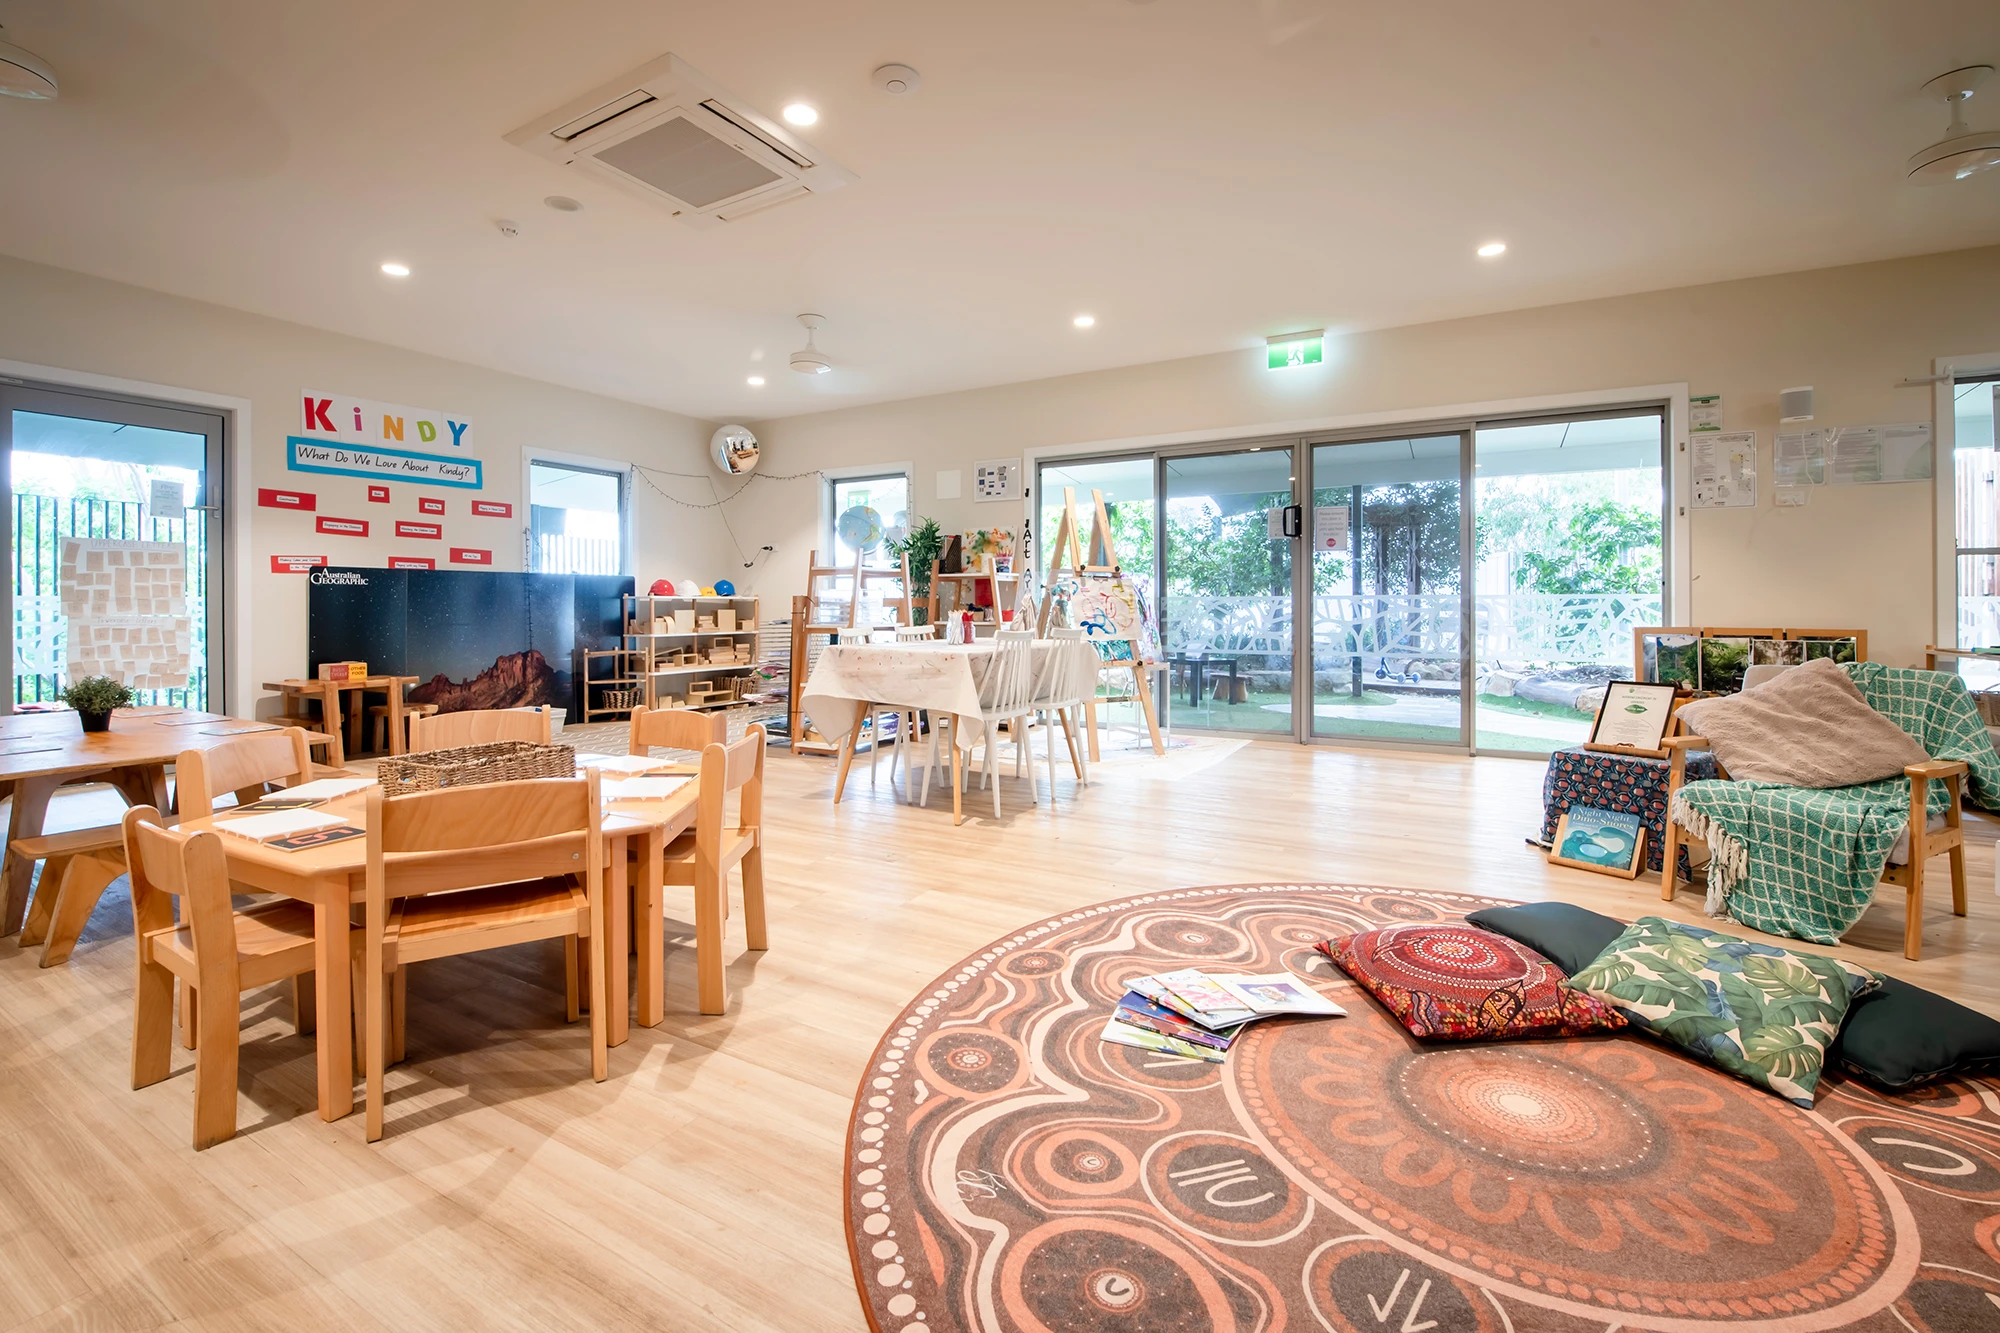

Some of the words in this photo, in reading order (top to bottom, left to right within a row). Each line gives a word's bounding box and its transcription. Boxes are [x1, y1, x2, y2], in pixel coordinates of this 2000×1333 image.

[304, 397, 468, 446] KiNDY
[298, 446, 330, 461] What
[335, 451, 349, 463] Do
[353, 453, 371, 466] We
[375, 456, 397, 469] Love
[402, 459, 429, 473] About
[438, 463, 470, 480] Kindy?
[310, 572, 369, 585] GEOGRAPHIC
[321, 568, 361, 579] Australian
[1579, 807, 1602, 817] Night
[1572, 813, 1635, 830] Dino-Snores
